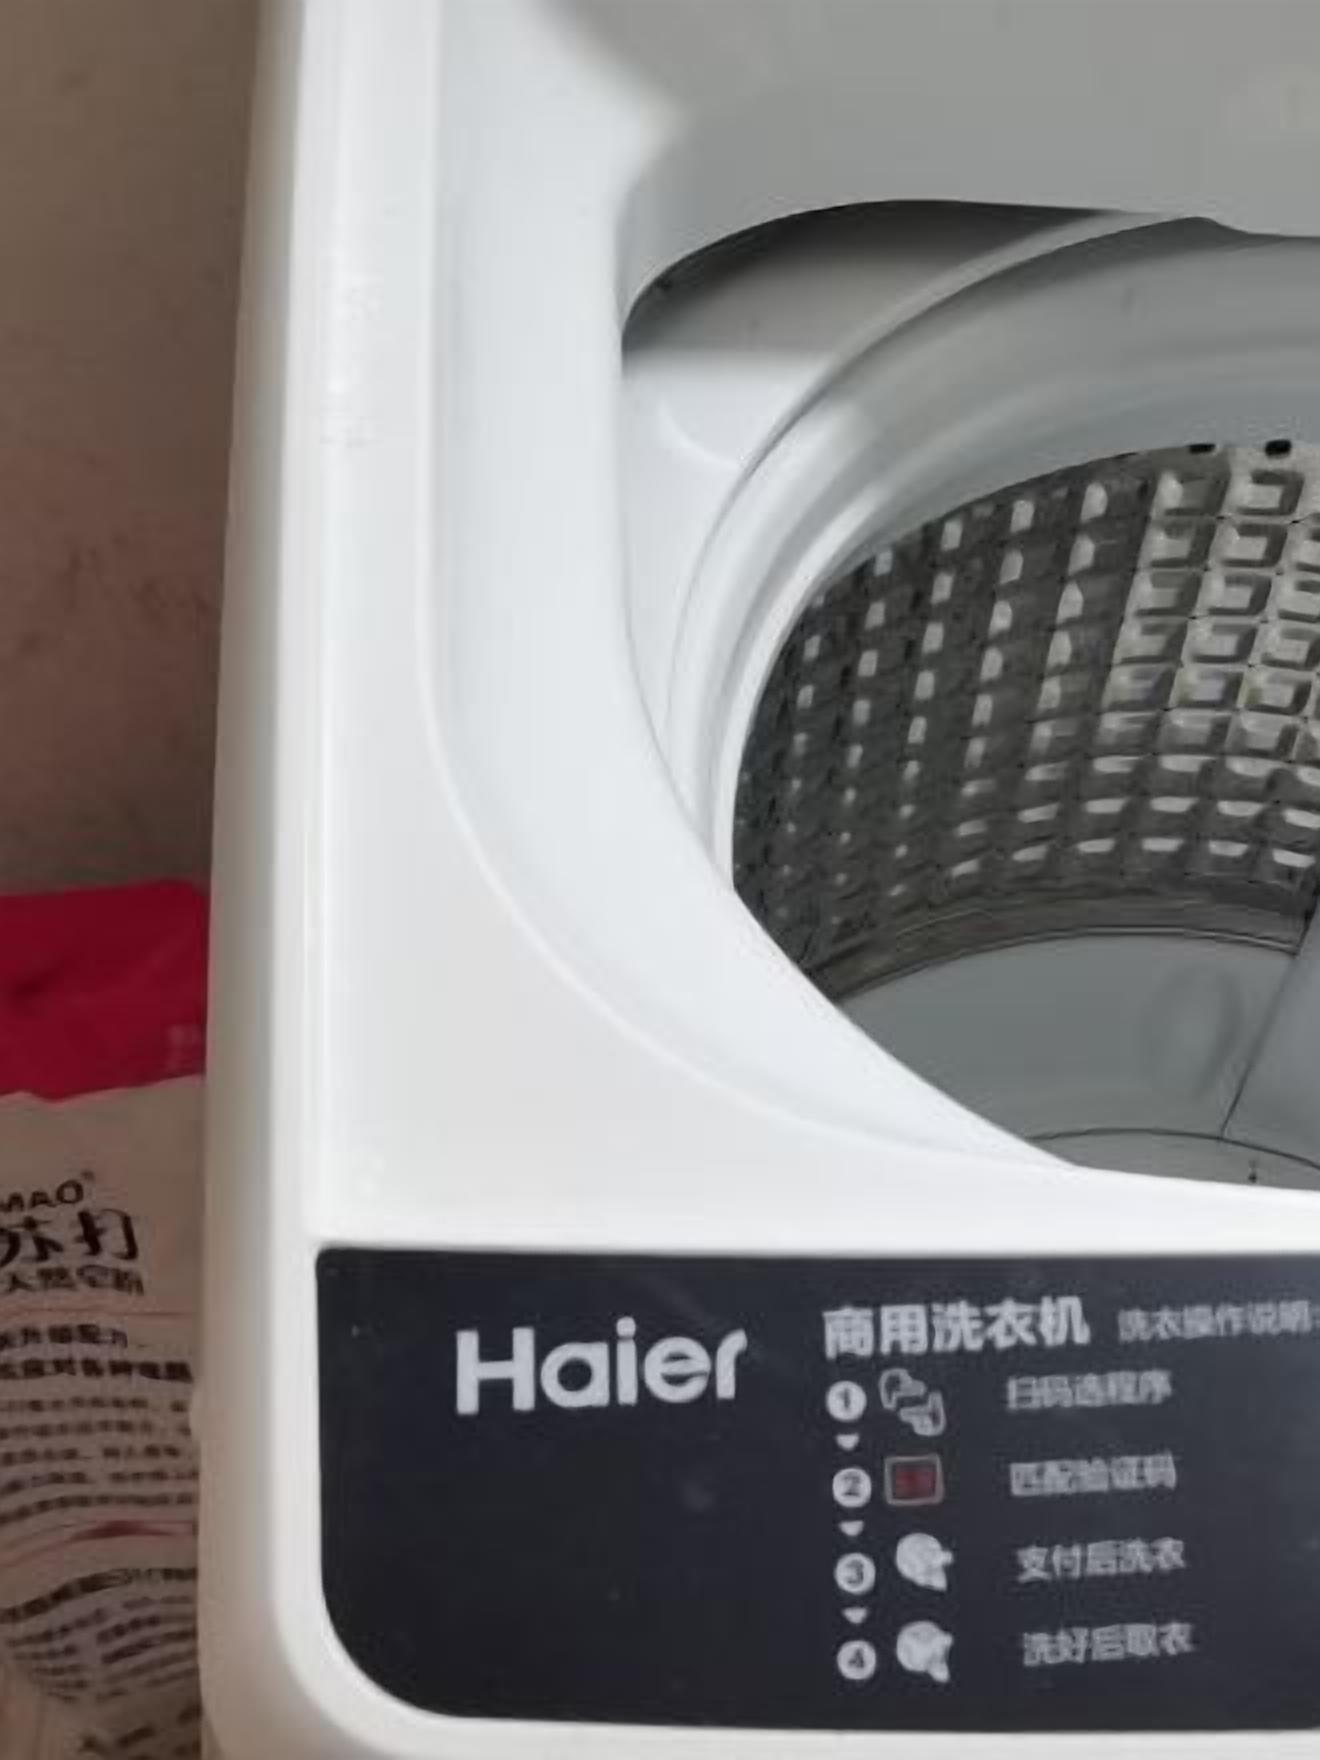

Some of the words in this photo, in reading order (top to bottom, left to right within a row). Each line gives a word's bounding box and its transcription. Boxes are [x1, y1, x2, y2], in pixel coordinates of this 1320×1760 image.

[822, 1296, 1091, 1360] 商用洗衣机
[456, 1316, 748, 1416] Haier
[1017, 1537, 1186, 1583] 支付后洗衣
